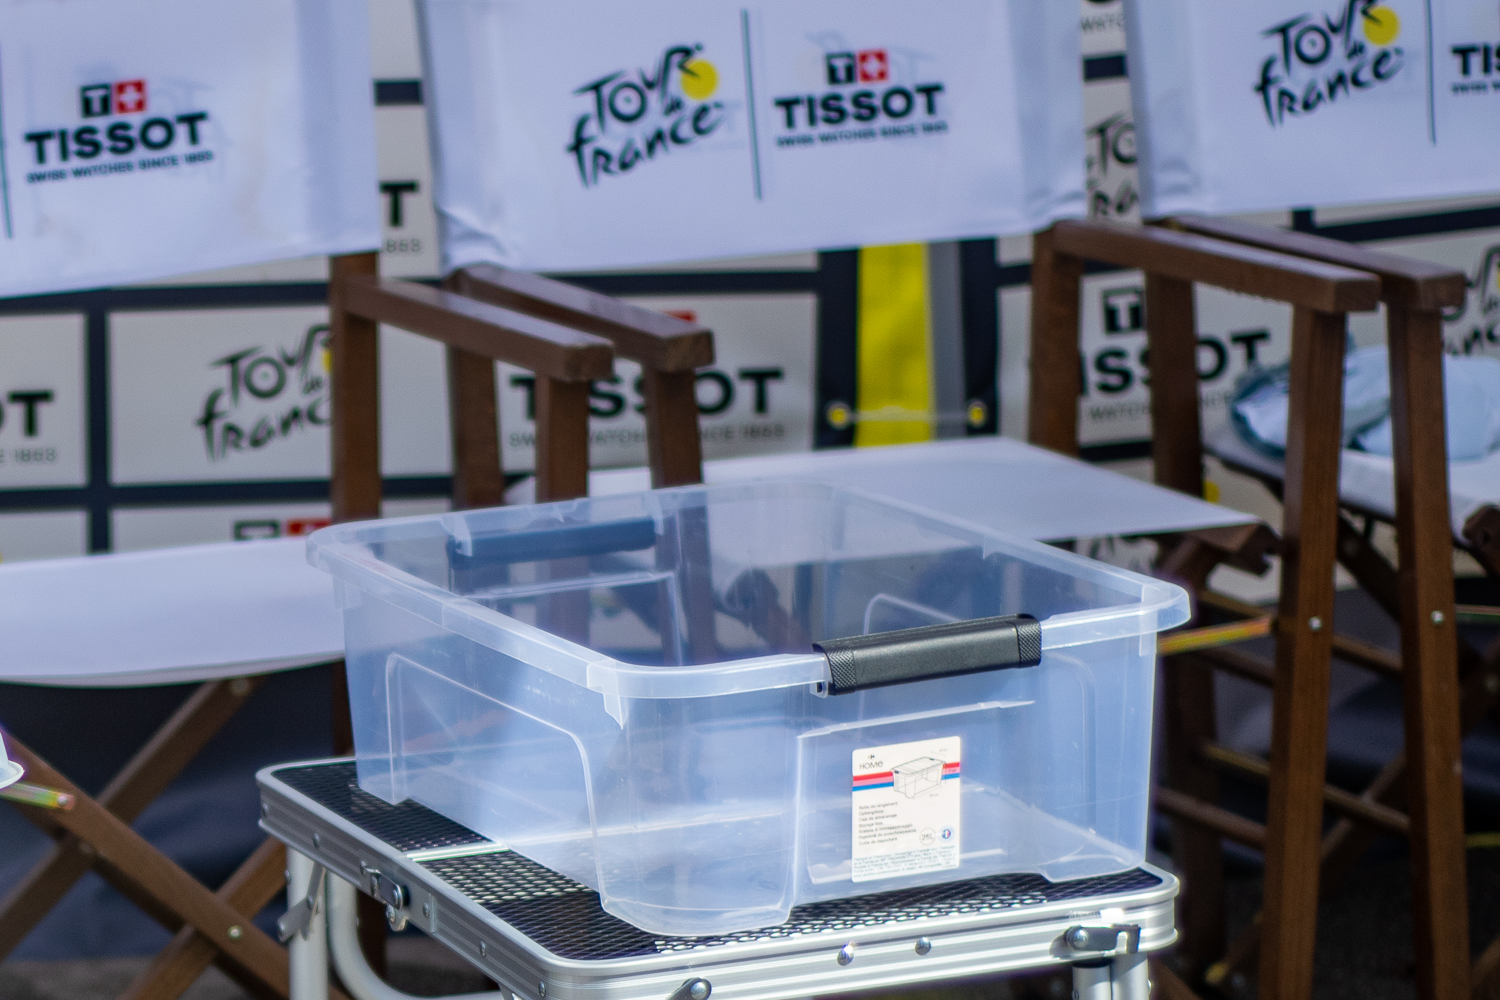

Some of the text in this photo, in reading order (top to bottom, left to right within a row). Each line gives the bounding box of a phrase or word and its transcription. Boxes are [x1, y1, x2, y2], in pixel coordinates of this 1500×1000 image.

[774, 82, 944, 130] TISSOT
[24, 110, 207, 164] TISSOT
[27, 168, 67, 184] SWISS
[71, 161, 133, 178] WATCHES
[139, 156, 179, 171] SINCE
[195, 388, 331, 462] franc
